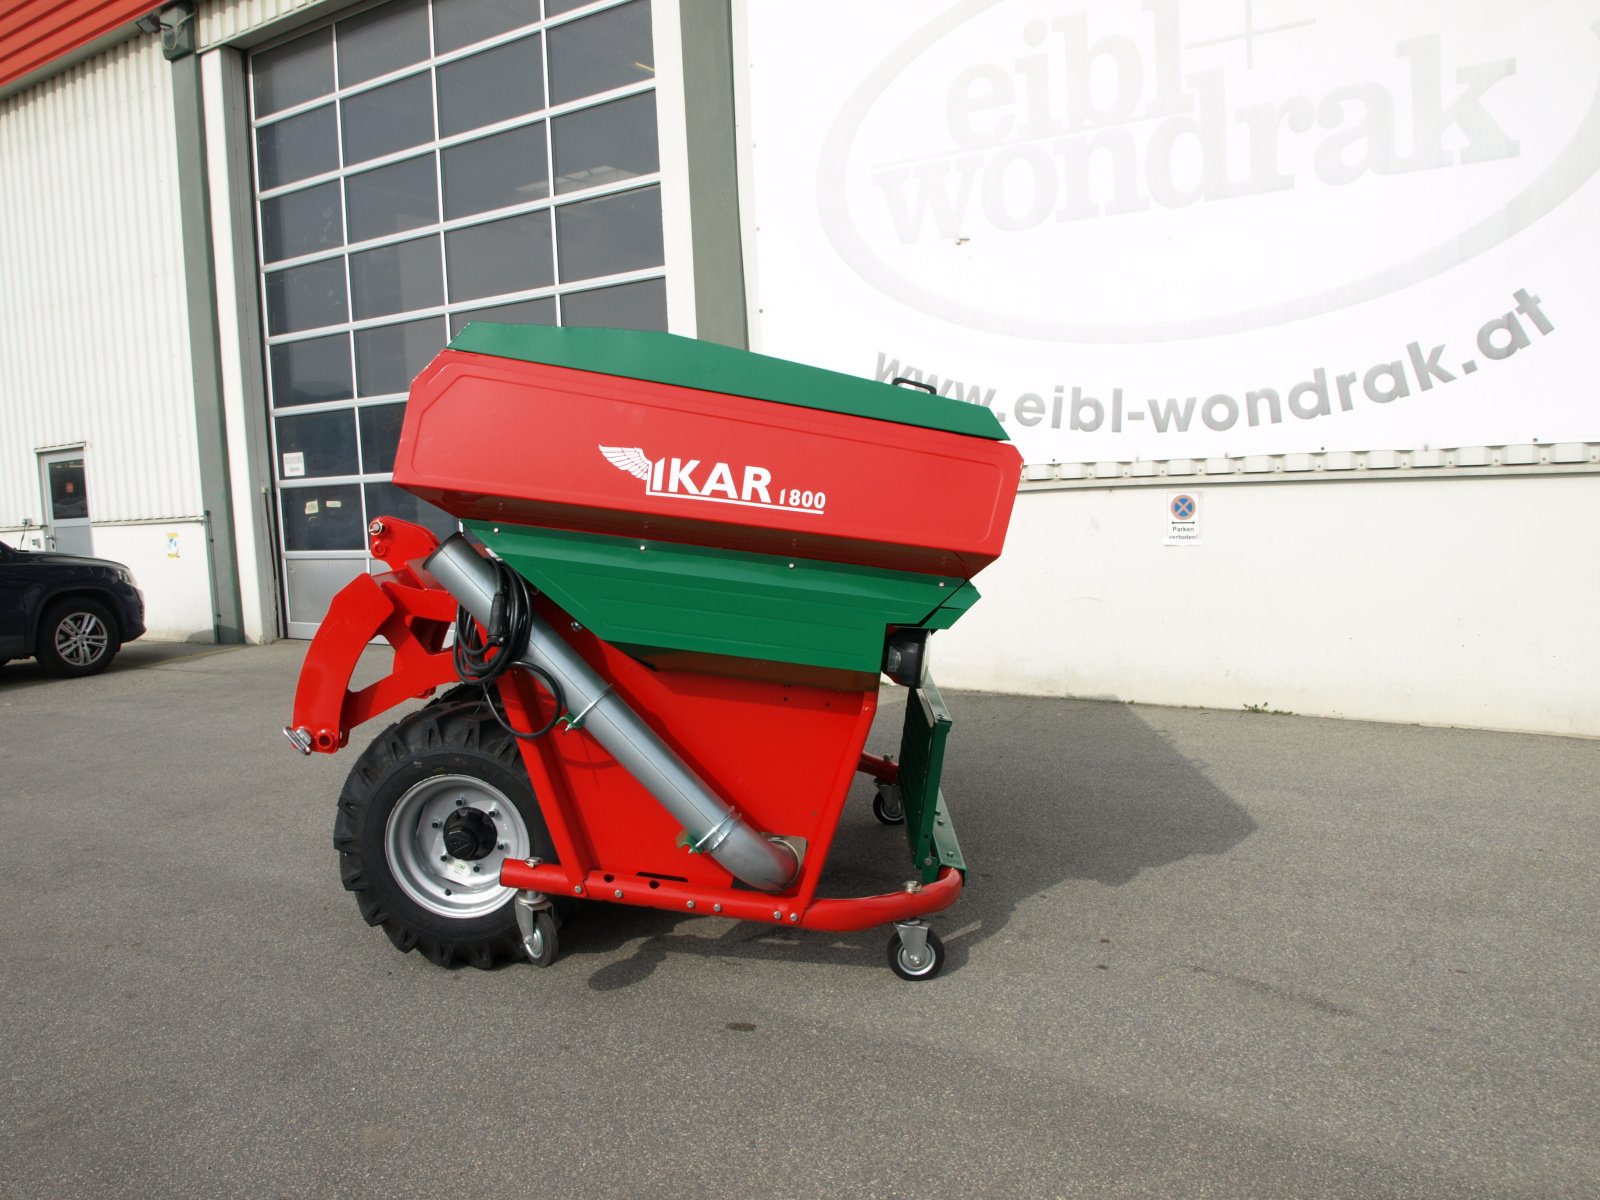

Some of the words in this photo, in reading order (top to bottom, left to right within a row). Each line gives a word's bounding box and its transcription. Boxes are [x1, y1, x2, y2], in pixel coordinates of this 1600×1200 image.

[872, 33, 1520, 245] wondrak
[945, 0, 1195, 151] eibl
[652, 457, 772, 504] IKAR
[779, 488, 826, 509] 1800
